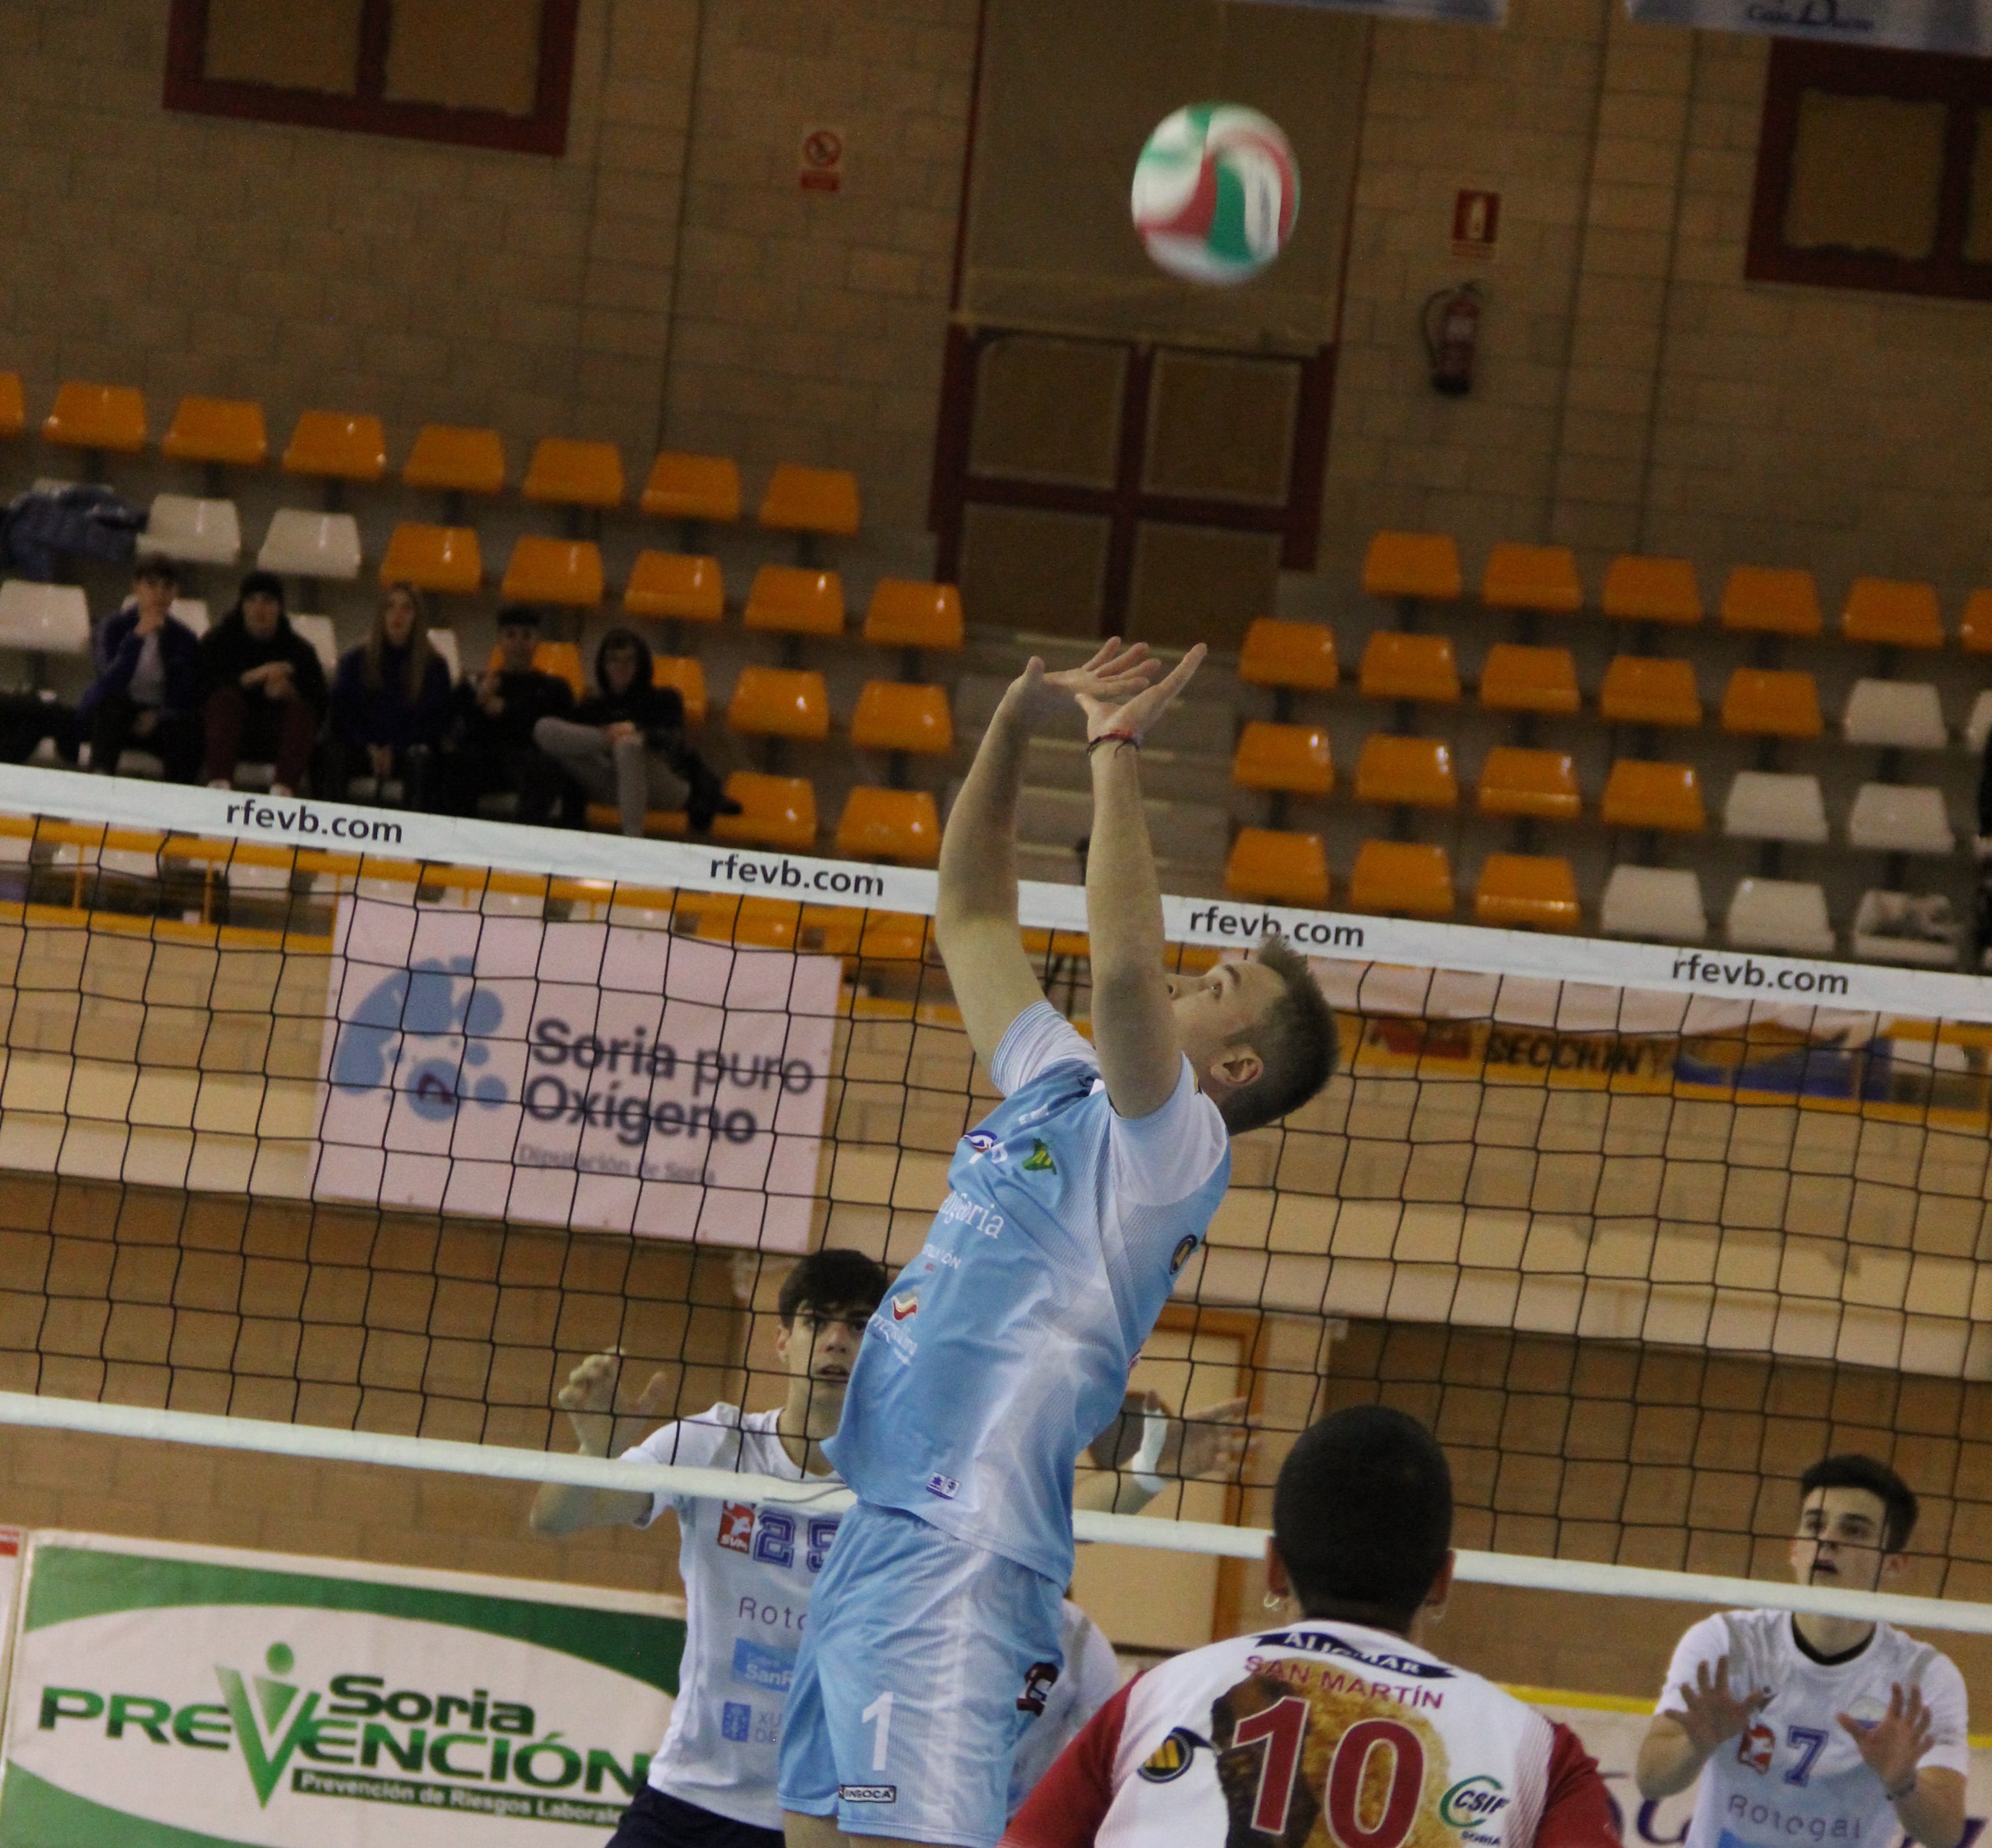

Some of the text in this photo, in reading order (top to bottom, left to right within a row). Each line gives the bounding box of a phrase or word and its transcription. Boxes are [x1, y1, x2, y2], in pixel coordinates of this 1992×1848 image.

[227, 799, 402, 843] rfevb.com
[710, 853, 884, 896] rfevb.com
[1189, 906, 1365, 947] rfevb.com
[1673, 954, 1849, 995] rfevb.com
[533, 1017, 814, 1097] Soria puro
[525, 1074, 758, 1146] Oxígeno
[329, 1673, 536, 1737] Soria
[1244, 1655, 1444, 1709] SAN MARTÍN
[37, 1663, 652, 1810] PREVENCIÓN
[861, 1690, 894, 1771] 1
[1784, 1725, 1829, 1787] 7
[301, 1772, 415, 1802] Prevención
[419, 1786, 445, 1806] de
[450, 1789, 531, 1816] Riesgos
[1231, 1695, 1428, 1848] 10
[1453, 1789, 1511, 1815] CSIF
[1729, 1794, 1861, 1842] Rotogal
